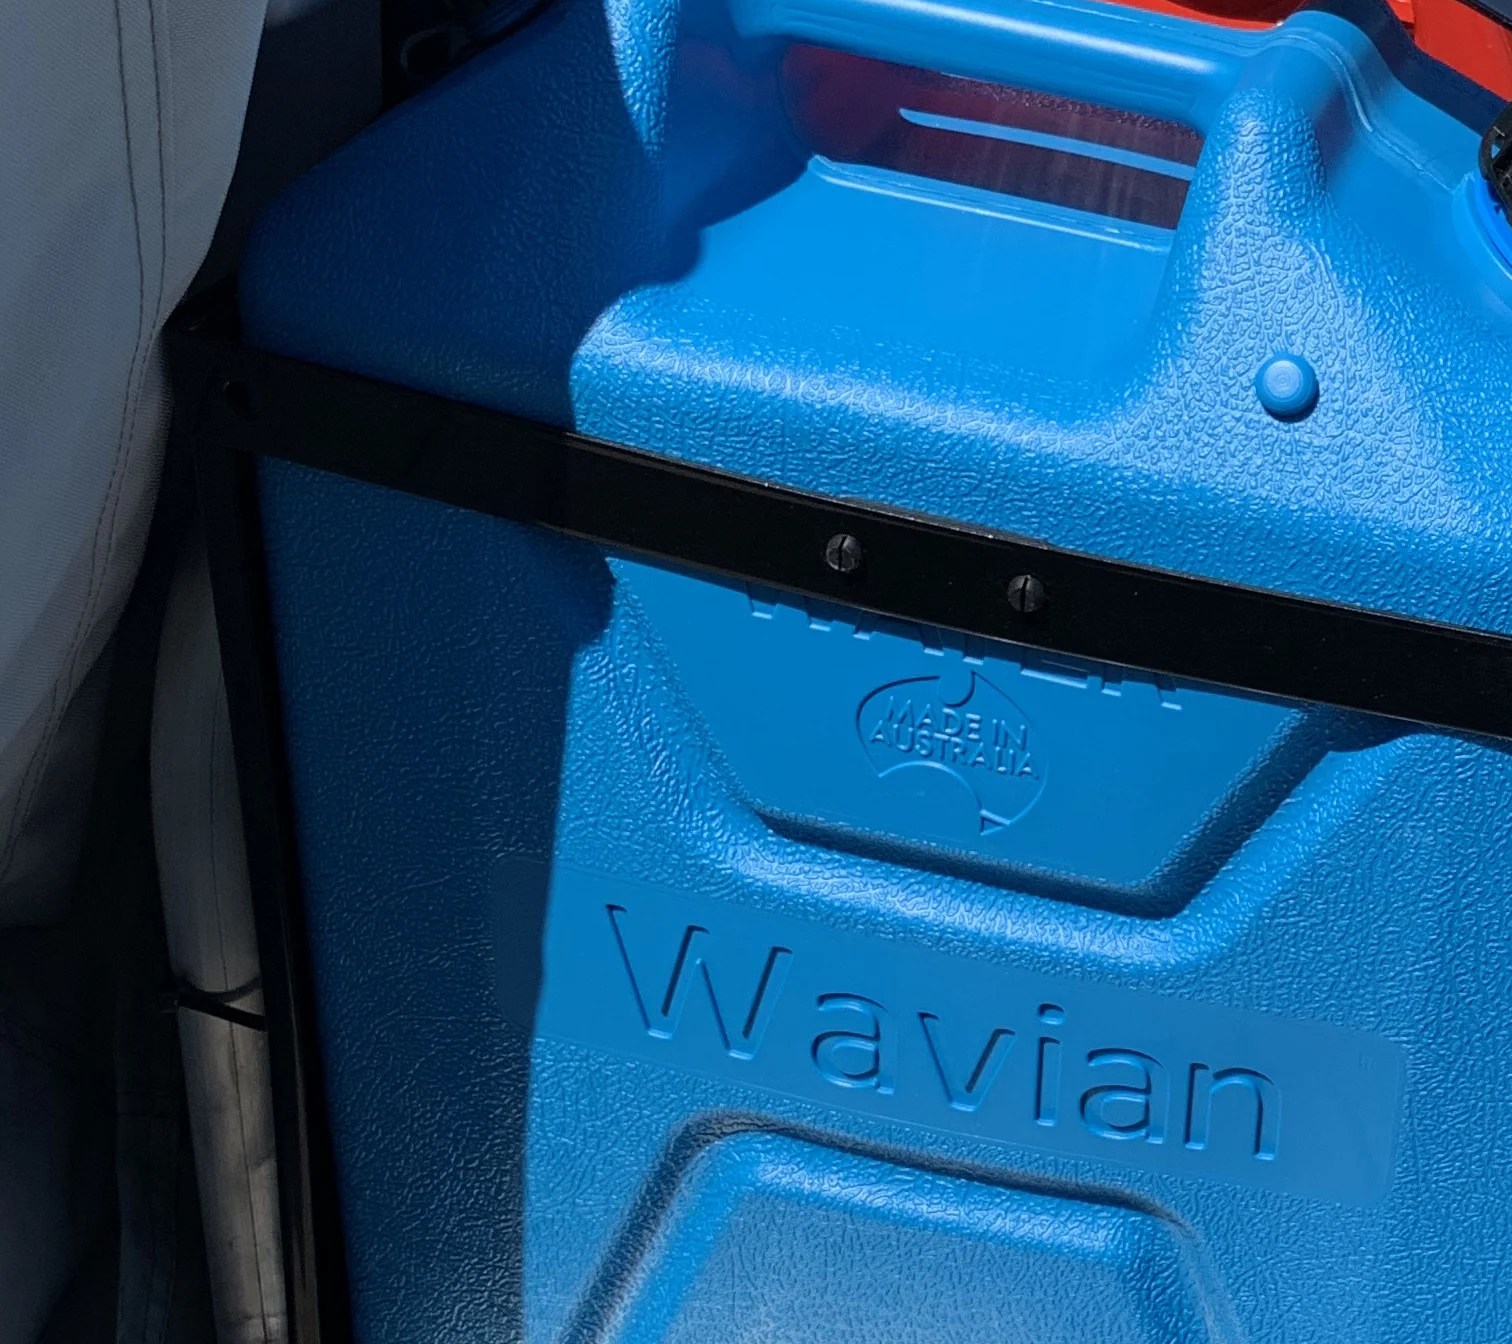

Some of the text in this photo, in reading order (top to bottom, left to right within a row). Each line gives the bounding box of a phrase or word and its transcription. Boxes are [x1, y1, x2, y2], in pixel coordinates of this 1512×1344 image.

[869, 720, 1040, 781] AUSTRALIA
[885, 695, 1028, 751] MADE IN
[605, 902, 1282, 1161] Wavian
